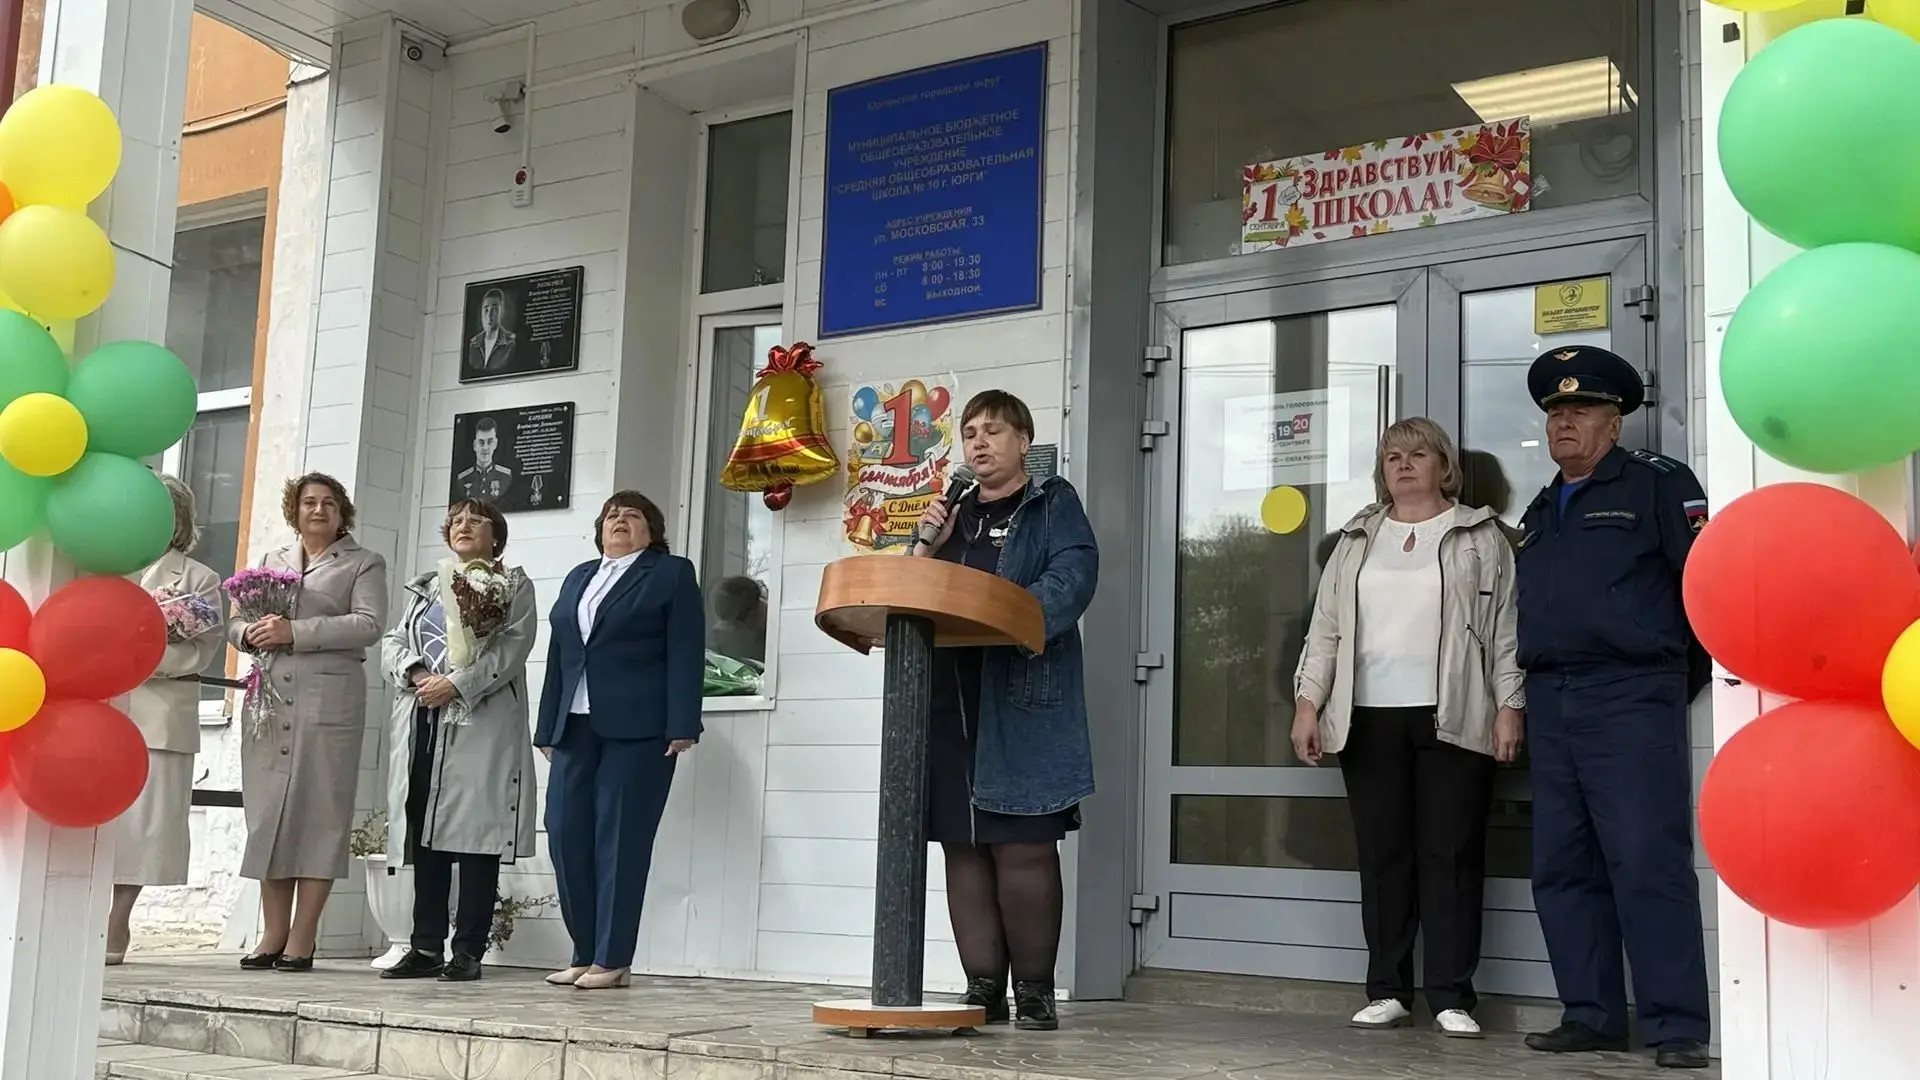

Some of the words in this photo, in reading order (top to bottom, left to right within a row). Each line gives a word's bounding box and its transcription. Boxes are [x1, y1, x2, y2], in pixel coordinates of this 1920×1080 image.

[848, 124, 943, 153] МУНИЦИПАЛЬНОЕ
[945, 108, 1020, 133] БЮДЖЕТНОЕ
[860, 126, 1003, 164] ОБЩЕОБРАЗОВАТЕЛЬНОЕ
[888, 147, 1034, 184] ОБЩЕОБРАЗОВАТЕЛЬНАЯ
[892, 146, 967, 169] УЧРЕЖДЕНИЕ
[871, 185, 910, 201] ШКОЛА
[913, 182, 925, 194] №
[928, 178, 940, 190] 10
[1260, 183, 1278, 222] 1
[1312, 179, 1454, 229] ШКОЛА!
[972, 214, 985, 227] 33
[953, 254, 981, 268] 19:30
[953, 268, 981, 282] 18:30
[883, 389, 919, 465] 1
[1278, 425, 1291, 437] 19
[1293, 418, 1309, 430] 20
[888, 501, 897, 513] С
